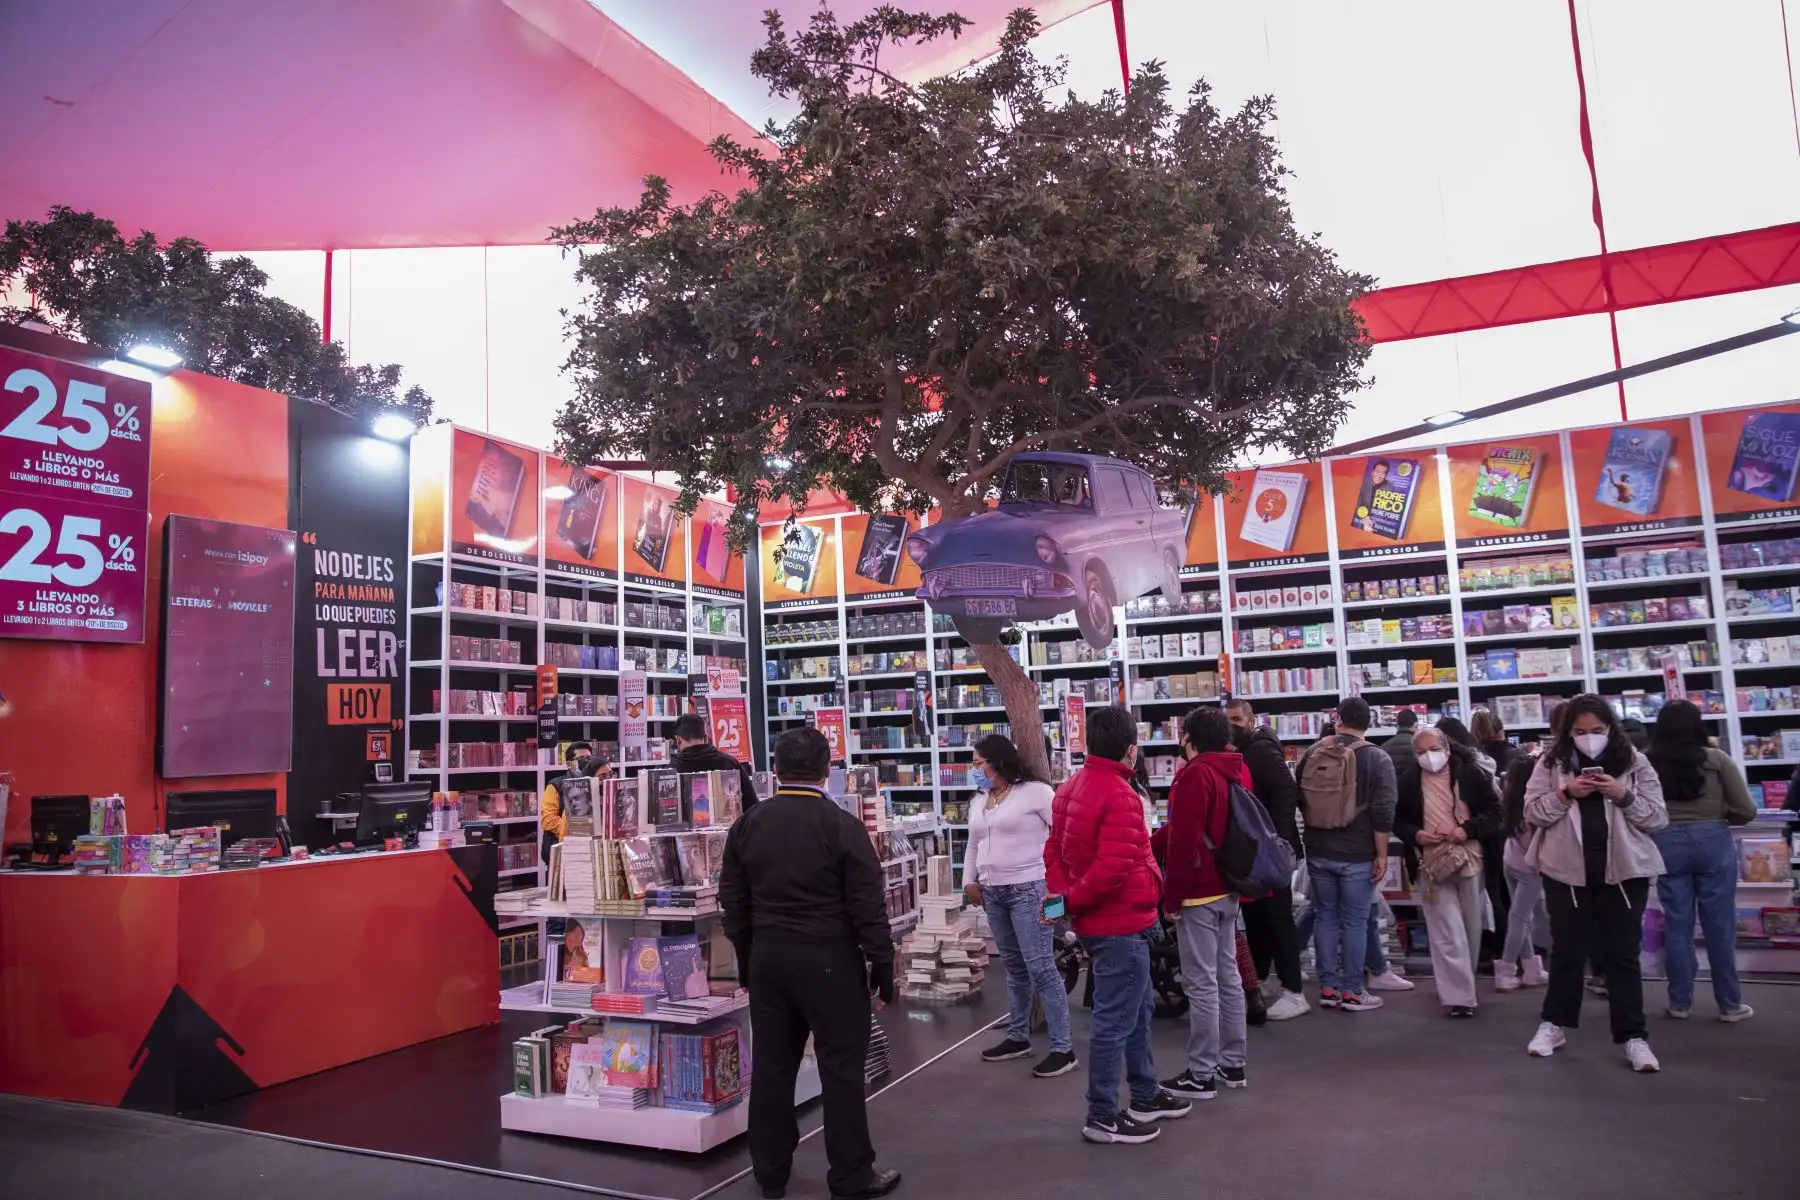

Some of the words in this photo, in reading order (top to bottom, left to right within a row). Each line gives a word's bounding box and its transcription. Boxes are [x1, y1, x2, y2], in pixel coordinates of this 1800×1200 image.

[1746, 425, 1797, 444] SIGUE
[1762, 443, 1798, 459] VOZ
[42, 450, 105, 470] LLEVANDO
[23, 458, 31, 469] 3
[35, 460, 78, 477] LIBROS
[81, 470, 91, 479] O
[95, 471, 120, 483] MÁS
[9, 471, 40, 483] LLEVANDO
[52, 478, 72, 488] LIBROS
[72, 482, 91, 491] OBTEN
[570, 475, 601, 504] KING
[1375, 489, 1406, 503] PADRE
[1264, 499, 1275, 512] 5
[1372, 497, 1404, 513] RICO
[1749, 509, 1800, 520] JUVENI
[1614, 522, 1666, 532] JUVENIL
[1475, 534, 1548, 546] ILUSTRADOS
[204, 548, 224, 558] Ahora
[238, 550, 269, 565] izipay
[467, 547, 478, 555] DE
[482, 550, 523, 563] BOLSILLO
[1362, 545, 1419, 556] NEGOCIOS
[314, 549, 340, 577] NO
[341, 552, 394, 583] DEJES
[1249, 557, 1306, 568] BIENESTAR
[570, 566, 605, 577] BOLSILLO
[645, 579, 675, 588] BOLSILLO
[692, 585, 720, 595] LITERATURA
[721, 589, 741, 598] CLÁSICA
[36, 589, 100, 604] LLEVANDO
[315, 582, 346, 600] PARA
[347, 584, 395, 604] MAÑANA
[863, 591, 905, 600] LITERATURA
[17, 600, 25, 611] 3
[29, 601, 72, 614] LIBROS
[76, 605, 86, 614] O
[89, 605, 115, 617] MÁS
[781, 599, 819, 608] LITERATURA
[3, 614, 34, 624] LLEVANDO
[46, 617, 66, 626] LIBROS
[355, 606, 396, 625] PUEDES
[316, 627, 399, 678] LEER
[339, 687, 382, 720] HOY
[717, 718, 740, 748] 25
